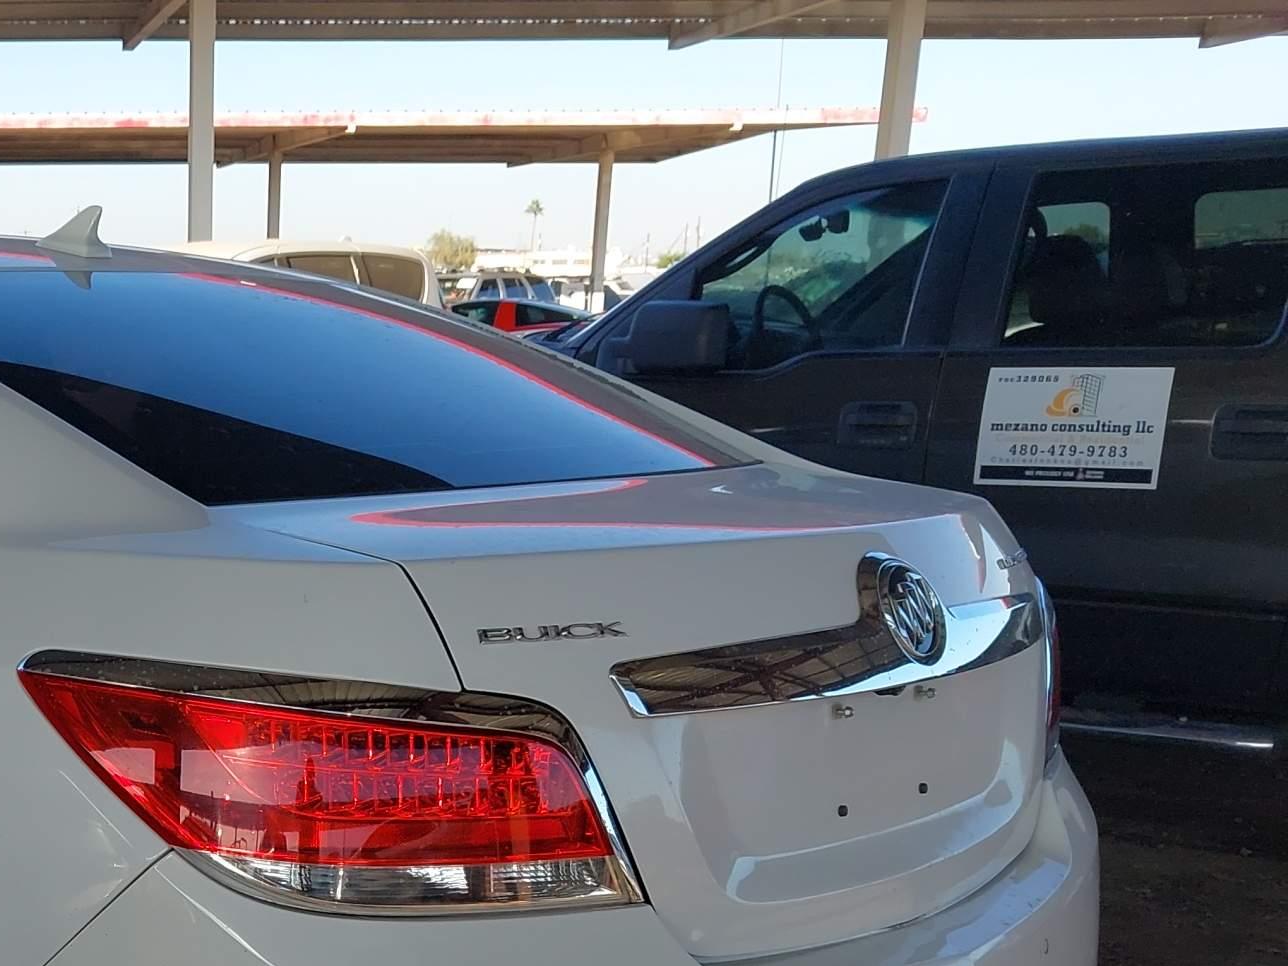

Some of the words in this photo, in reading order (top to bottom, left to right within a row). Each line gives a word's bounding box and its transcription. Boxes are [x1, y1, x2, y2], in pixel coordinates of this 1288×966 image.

[1051, 420, 1132, 436] consulting
[1135, 421, 1154, 433] llc
[1009, 443, 1128, 457] 480-479-9783
[477, 621, 628, 645] BUICK
